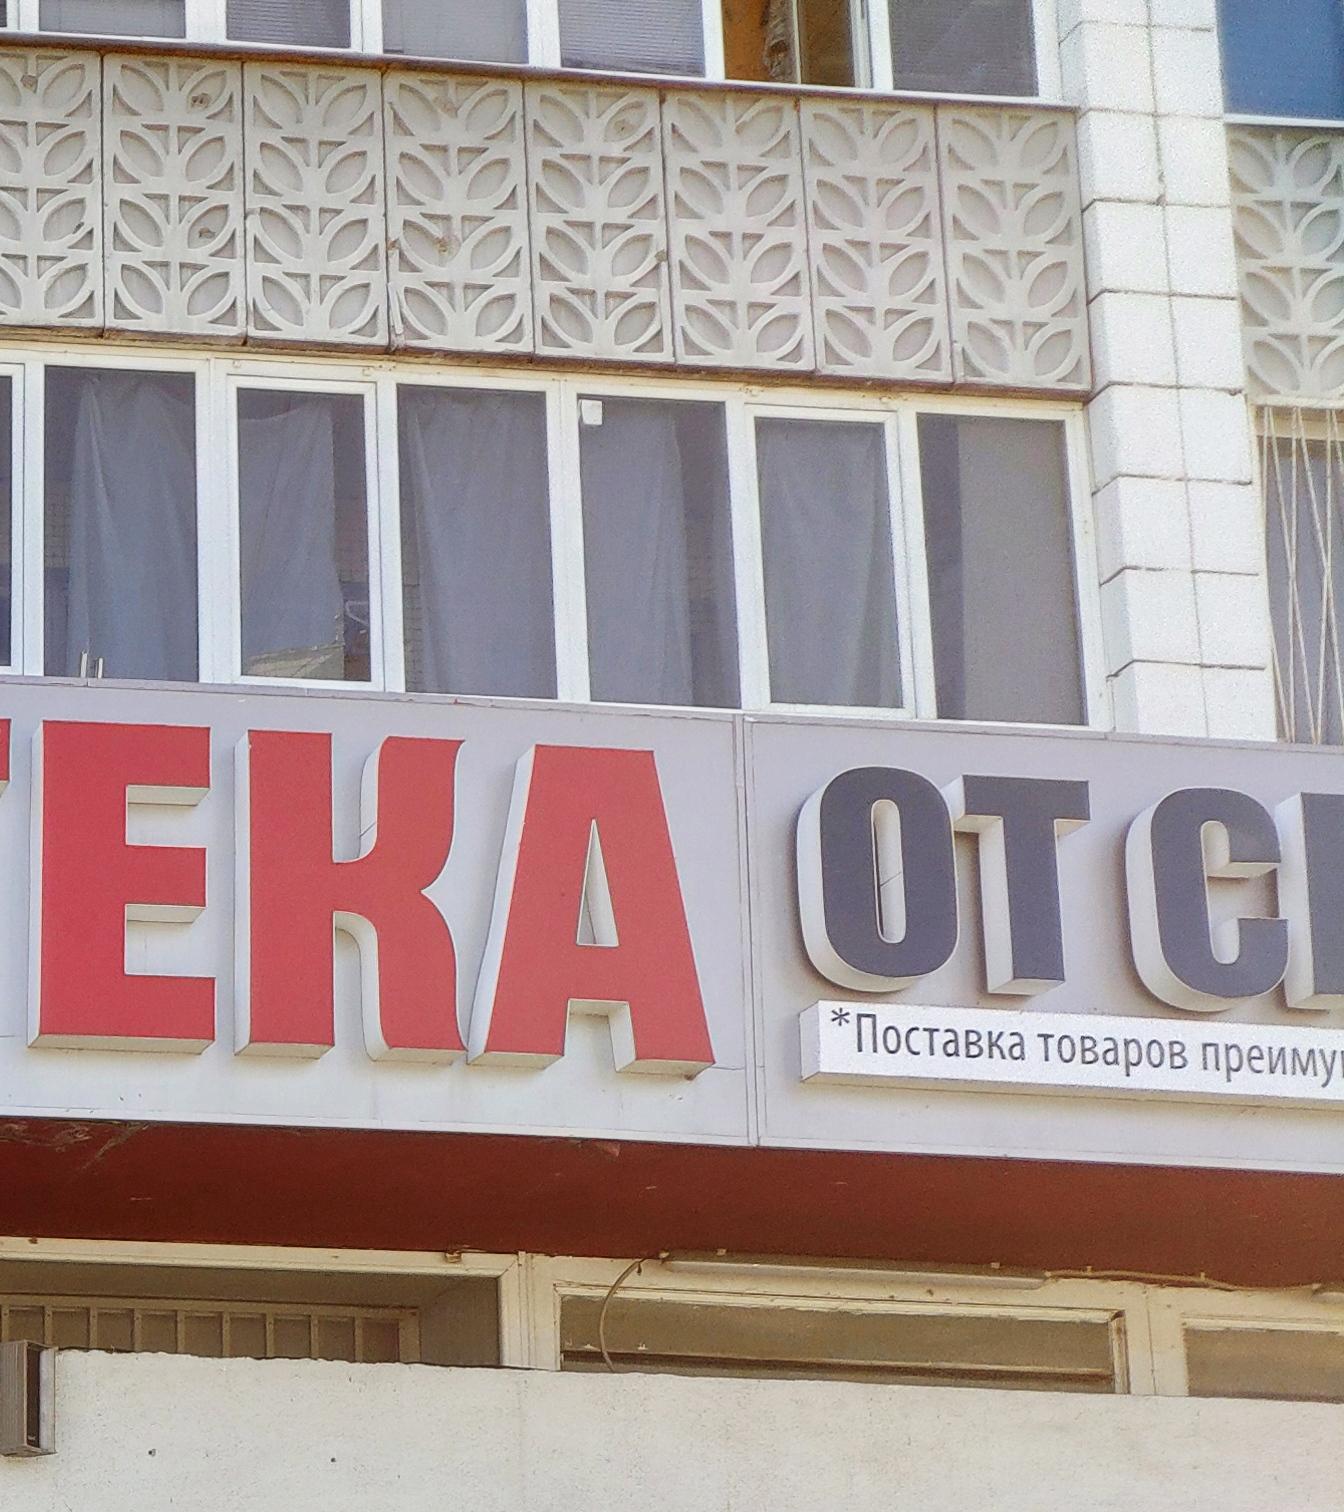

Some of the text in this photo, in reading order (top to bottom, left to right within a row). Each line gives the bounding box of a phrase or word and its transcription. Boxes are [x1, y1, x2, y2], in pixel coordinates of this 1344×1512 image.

[797, 765, 1344, 1012] ОТ С
[1038, 1031, 1188, 1077] товаров
[1201, 1041, 1344, 1088] преиму
